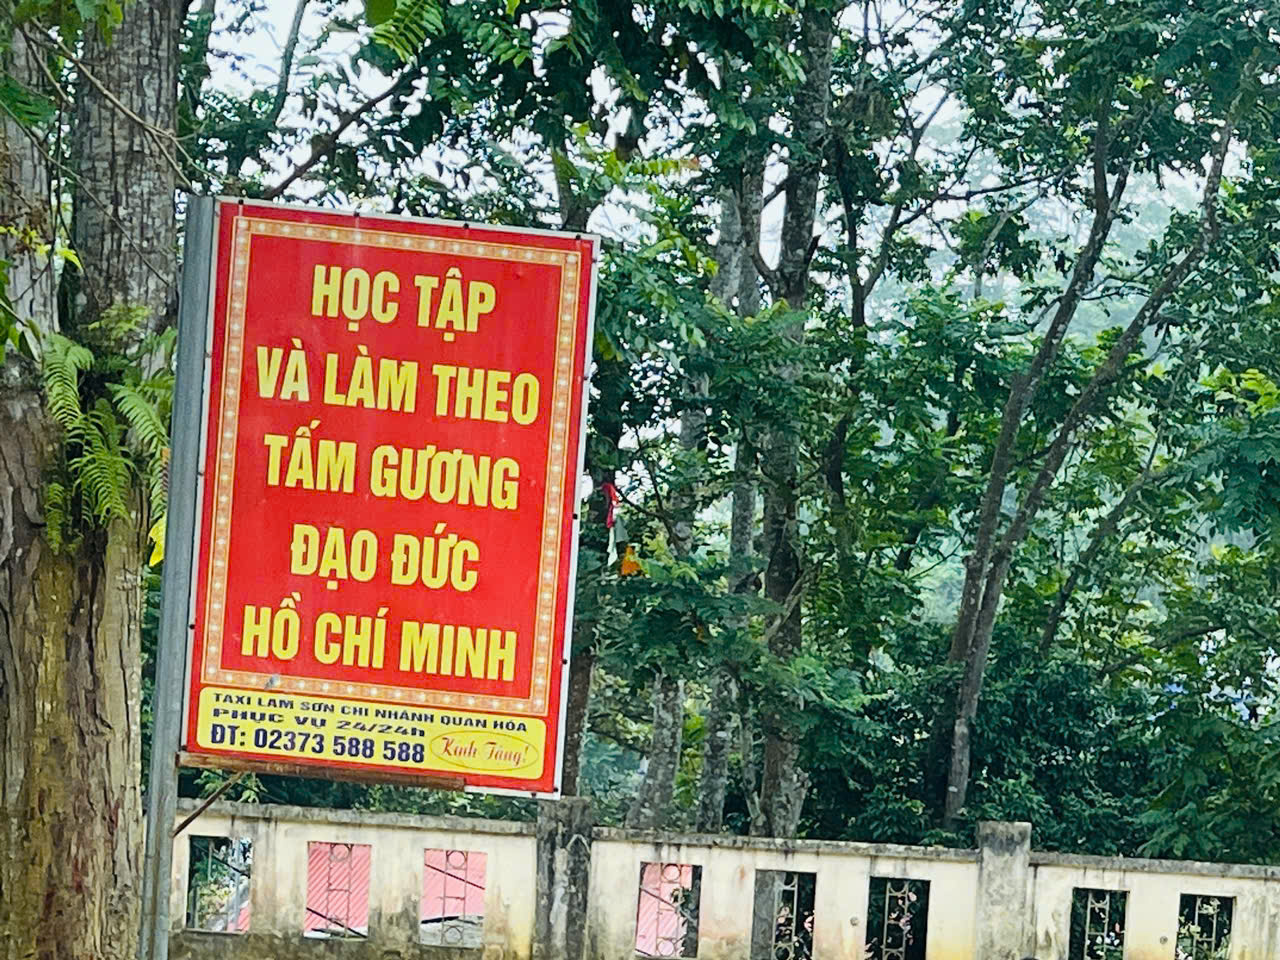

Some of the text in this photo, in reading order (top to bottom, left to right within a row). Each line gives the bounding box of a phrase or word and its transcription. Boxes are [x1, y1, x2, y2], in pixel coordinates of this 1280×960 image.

[311, 264, 497, 342] HỌC TẬP
[256, 337, 540, 426] VÀ LÀM THEO
[263, 419, 520, 511] TẤM GƯƠNG
[290, 522, 480, 592] ĐẠO ĐỨC
[241, 591, 518, 682] HỒ CHÍ MINH
[211, 723, 425, 763] ĐT: 02373 588 588
[213, 692, 252, 705] TAXI
[300, 701, 335, 713] SƠN
[340, 705, 369, 716] CHI
[374, 708, 434, 724] NHÁNH
[440, 715, 487, 729] QUAN
[492, 718, 527, 732] HÓA
[213, 708, 425, 737] PHỤC VỤ 24/24h
